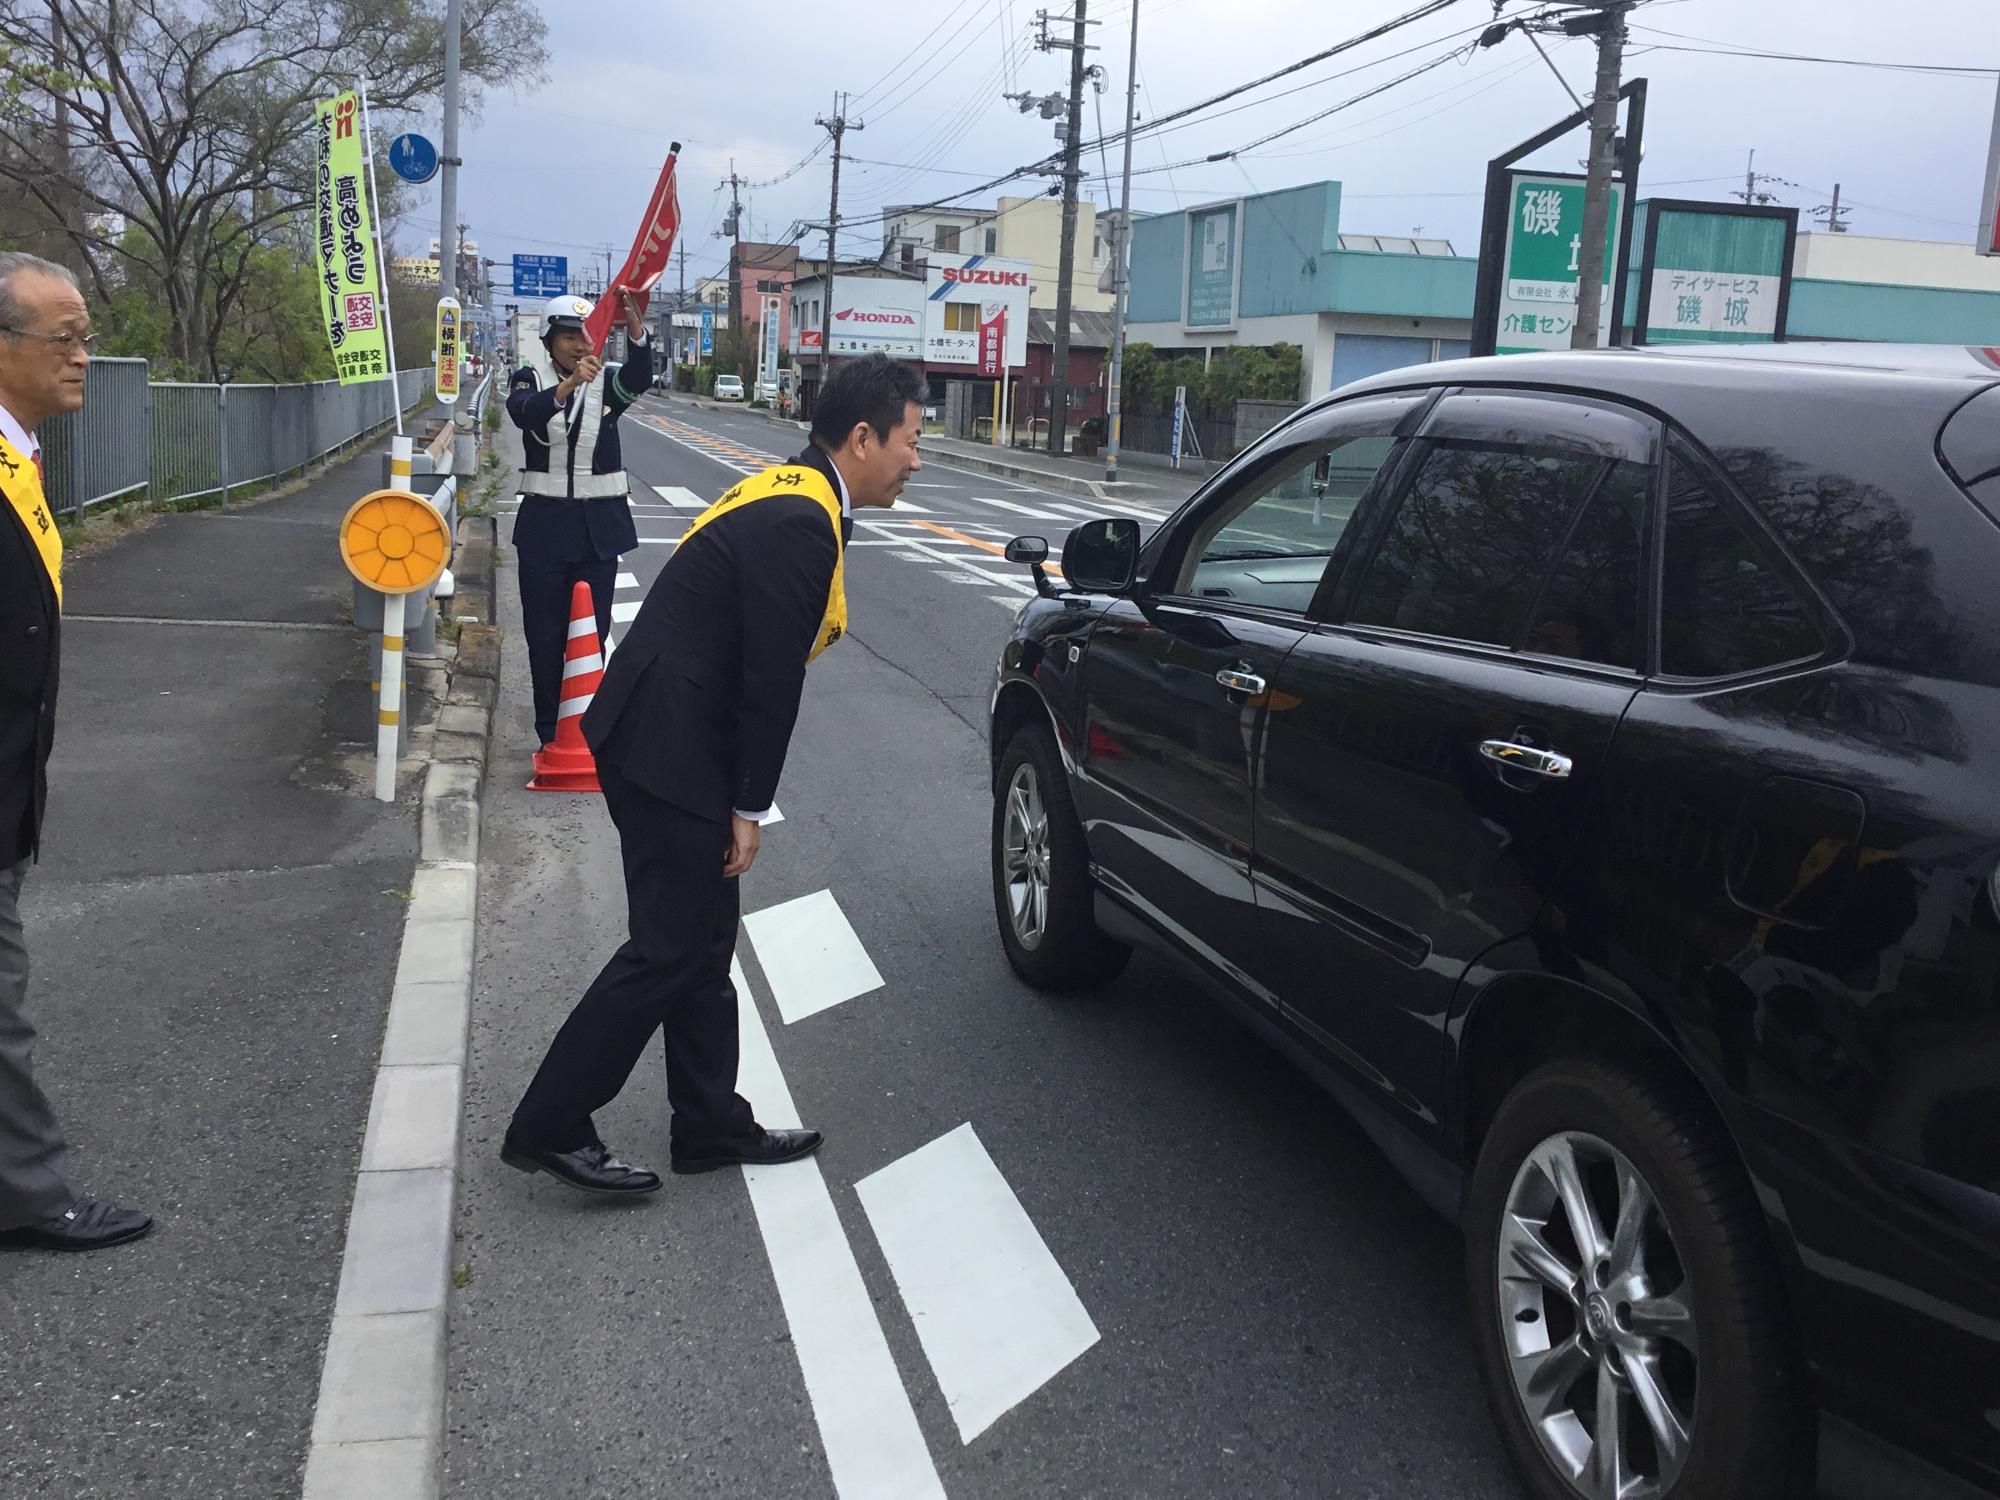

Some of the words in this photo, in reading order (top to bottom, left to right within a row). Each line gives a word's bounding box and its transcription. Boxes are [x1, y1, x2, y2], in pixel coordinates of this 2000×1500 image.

[942, 267, 1028, 287] SUZUKI
[1671, 276, 1759, 294] デイサービス
[1517, 287, 1552, 297] 有限会社
[853, 312, 915, 324] HONDA
[1504, 313, 1604, 334] 介護セン
[441, 327, 455, 386] 横断注意
[985, 326, 998, 374] 南都銀行
